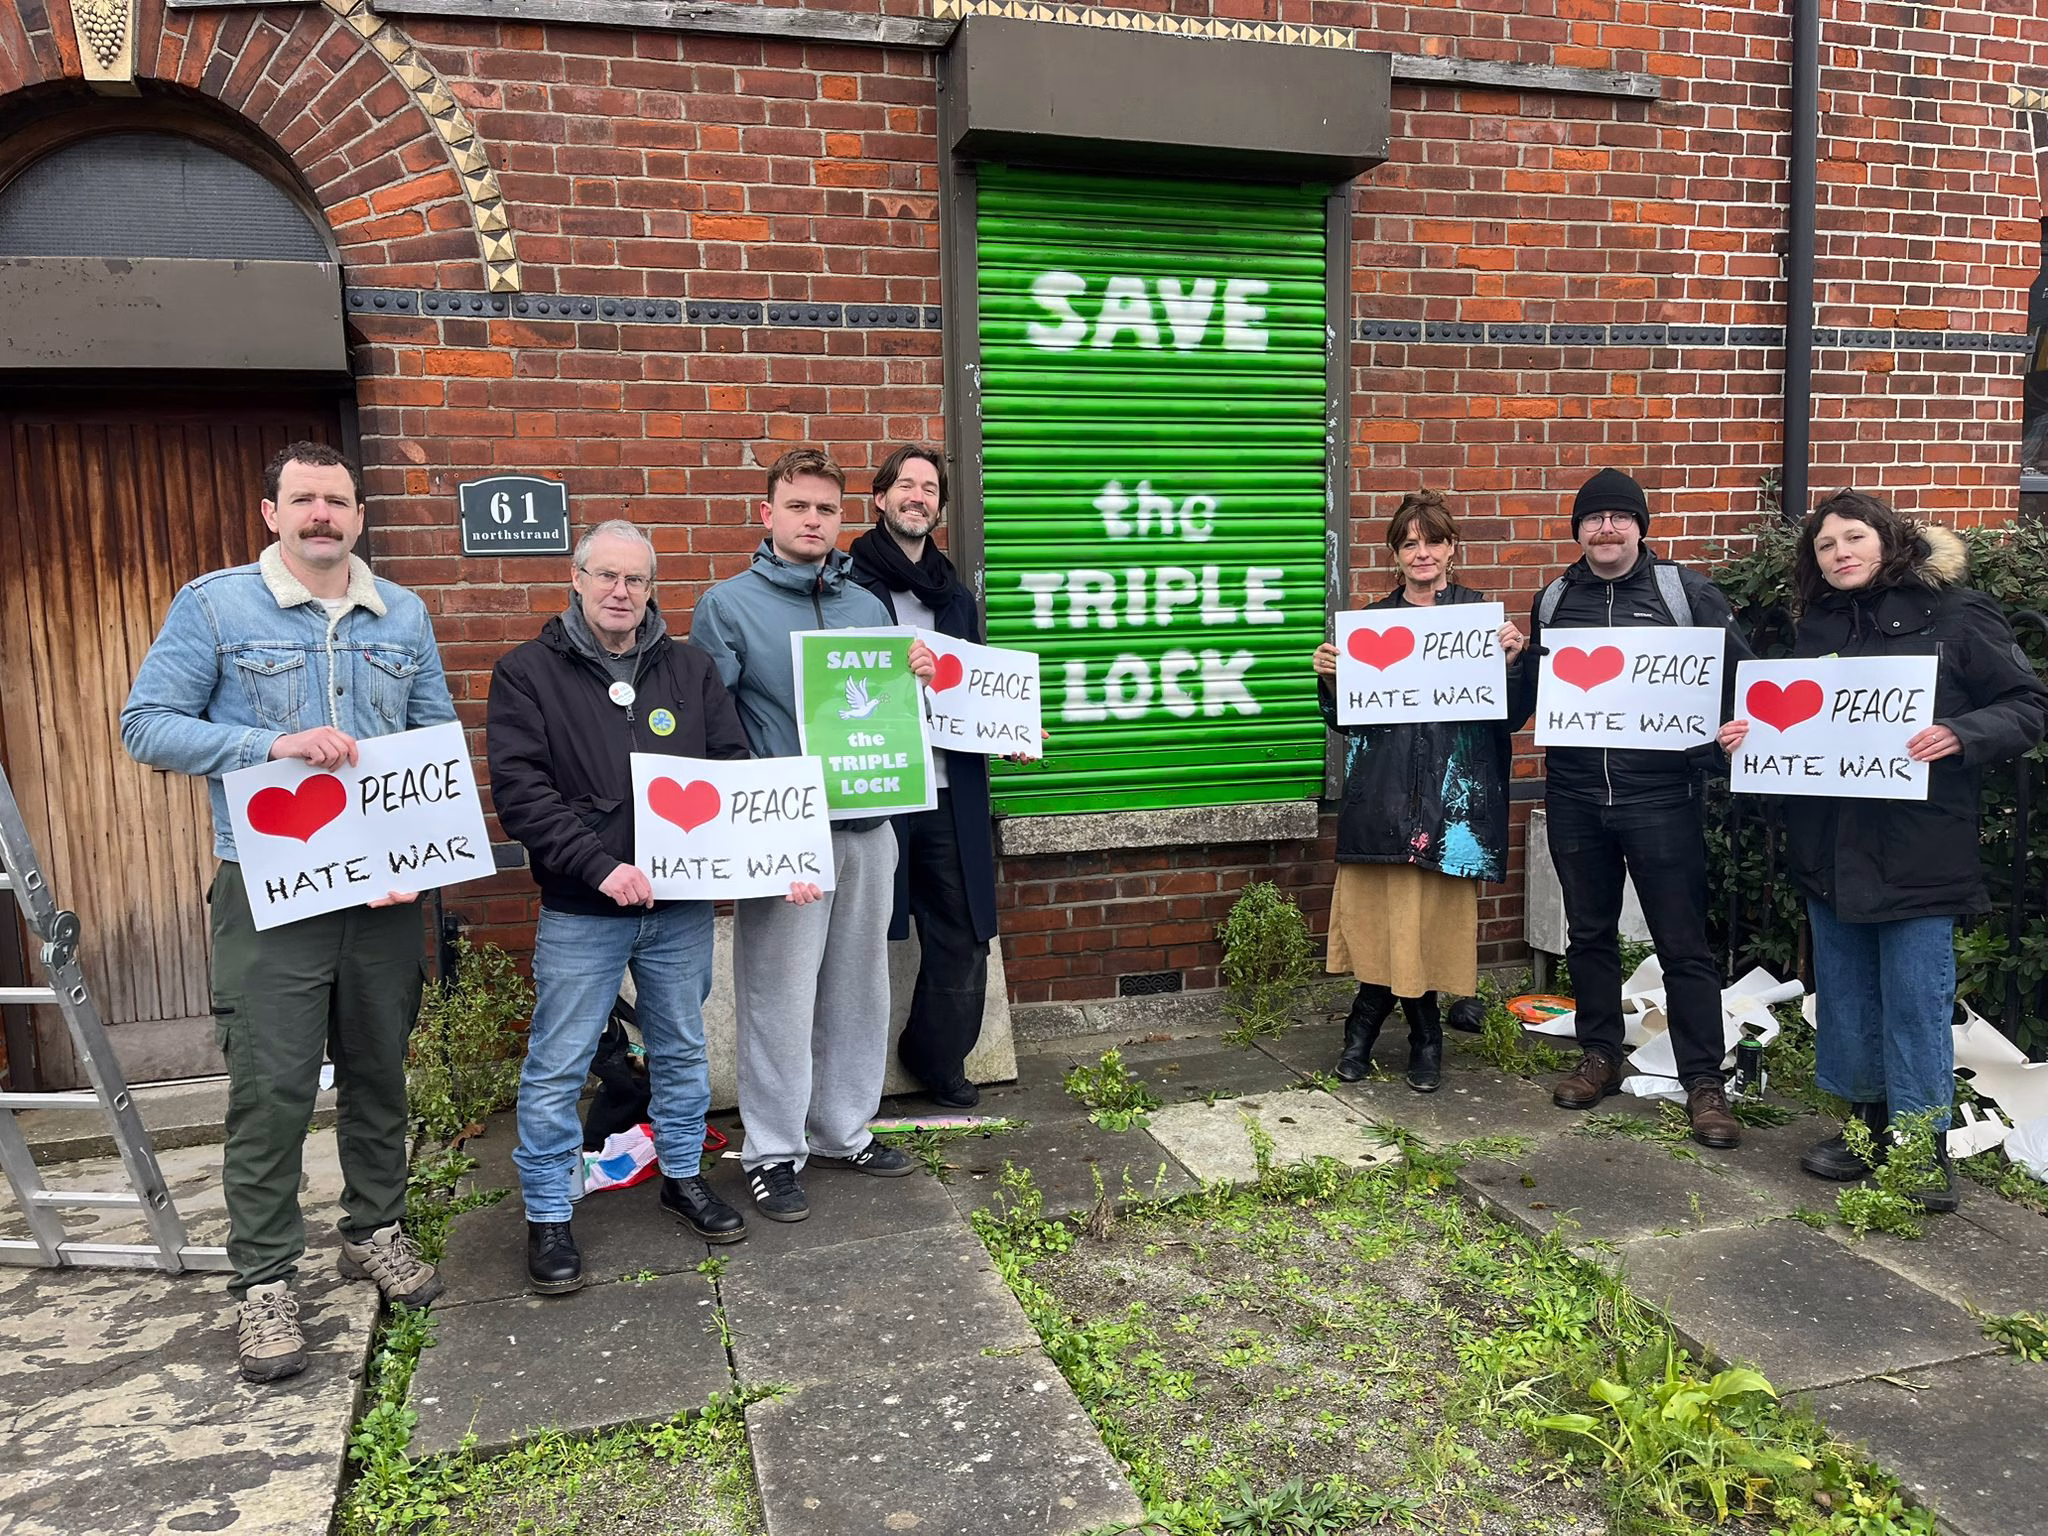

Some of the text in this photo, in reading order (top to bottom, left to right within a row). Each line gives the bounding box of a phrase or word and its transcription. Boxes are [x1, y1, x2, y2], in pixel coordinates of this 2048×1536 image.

[1026, 272, 1270, 354] SAVE
[490, 492, 539, 524] 61
[1093, 481, 1220, 541] the
[472, 529, 559, 541] northstrand
[1018, 567, 1284, 628] TRIPLE
[827, 651, 891, 669] SAVE
[1423, 630, 1496, 660] PEACE
[969, 670, 1032, 700] PEACE
[1061, 650, 1261, 721] LOCK
[1632, 655, 1716, 686] PEACE
[1350, 686, 1494, 708] HATE WAR
[1832, 688, 1924, 723] PEACE
[927, 715, 1030, 743] ATE WAR
[1549, 712, 1706, 736] HATE WAR
[848, 732, 885, 747] the
[828, 752, 908, 772] TRIPLE
[1743, 754, 1912, 782] HATE WAR
[358, 758, 461, 816] PEACE
[841, 777, 900, 794] LOCK
[732, 787, 816, 823] PEACE
[265, 835, 475, 904] HATE WAR
[652, 854, 820, 879] HATE WAR
